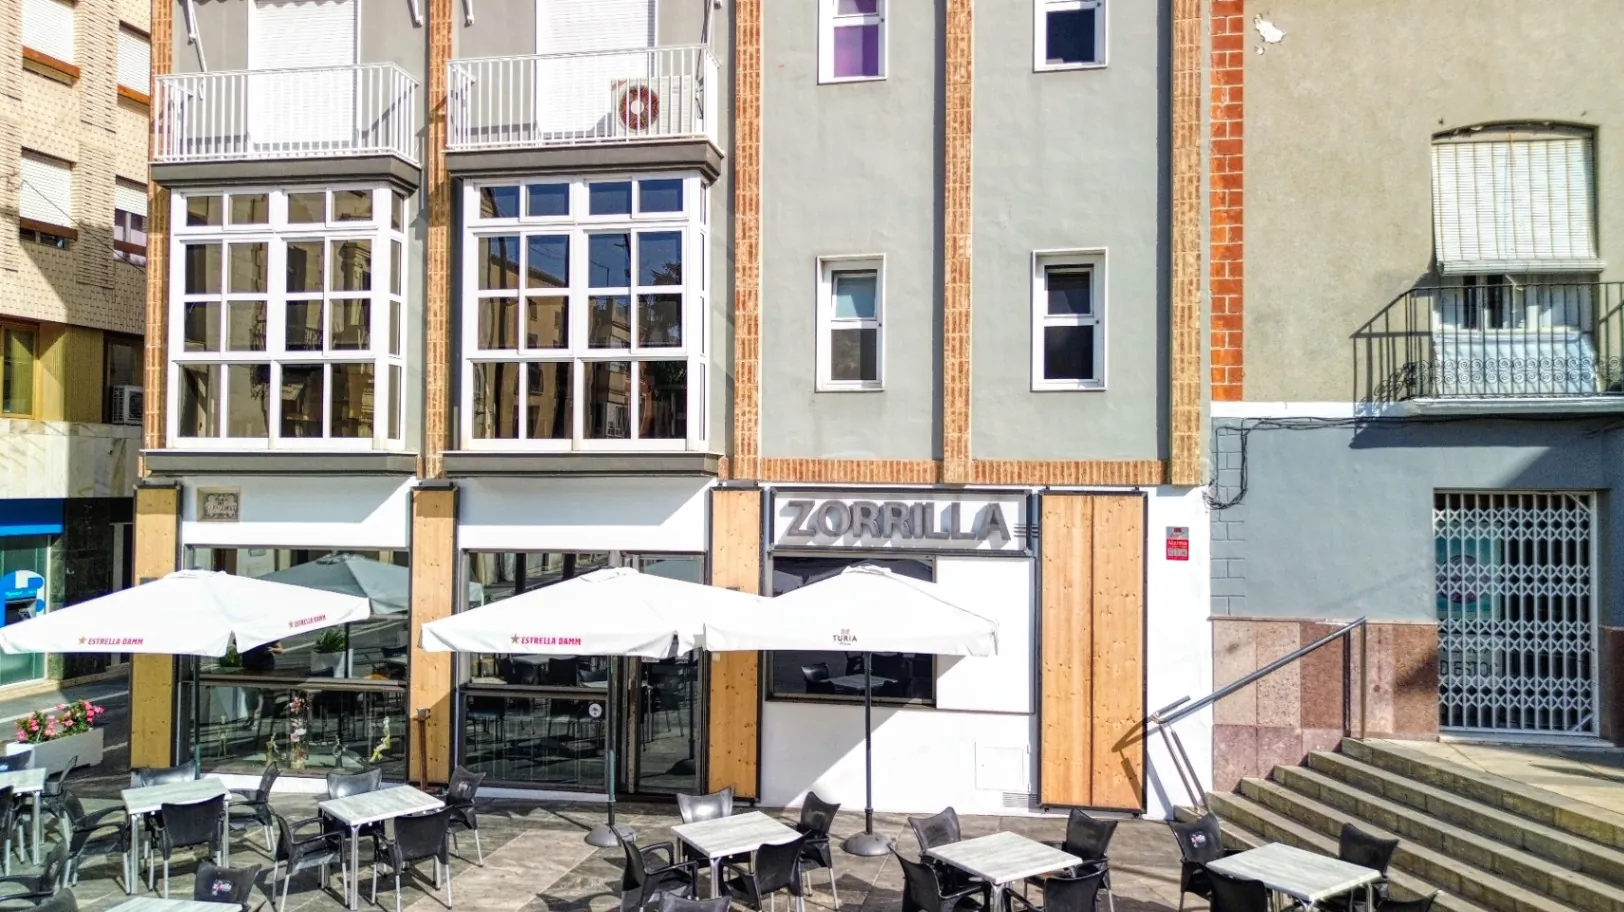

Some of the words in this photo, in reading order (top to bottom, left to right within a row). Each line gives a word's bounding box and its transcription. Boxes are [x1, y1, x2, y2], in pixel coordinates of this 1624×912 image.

[787, 500, 1012, 541] ZORRILLA
[521, 636, 556, 645] ESTRELLA
[558, 637, 582, 646] DAMM
[832, 634, 858, 643] TURIA
